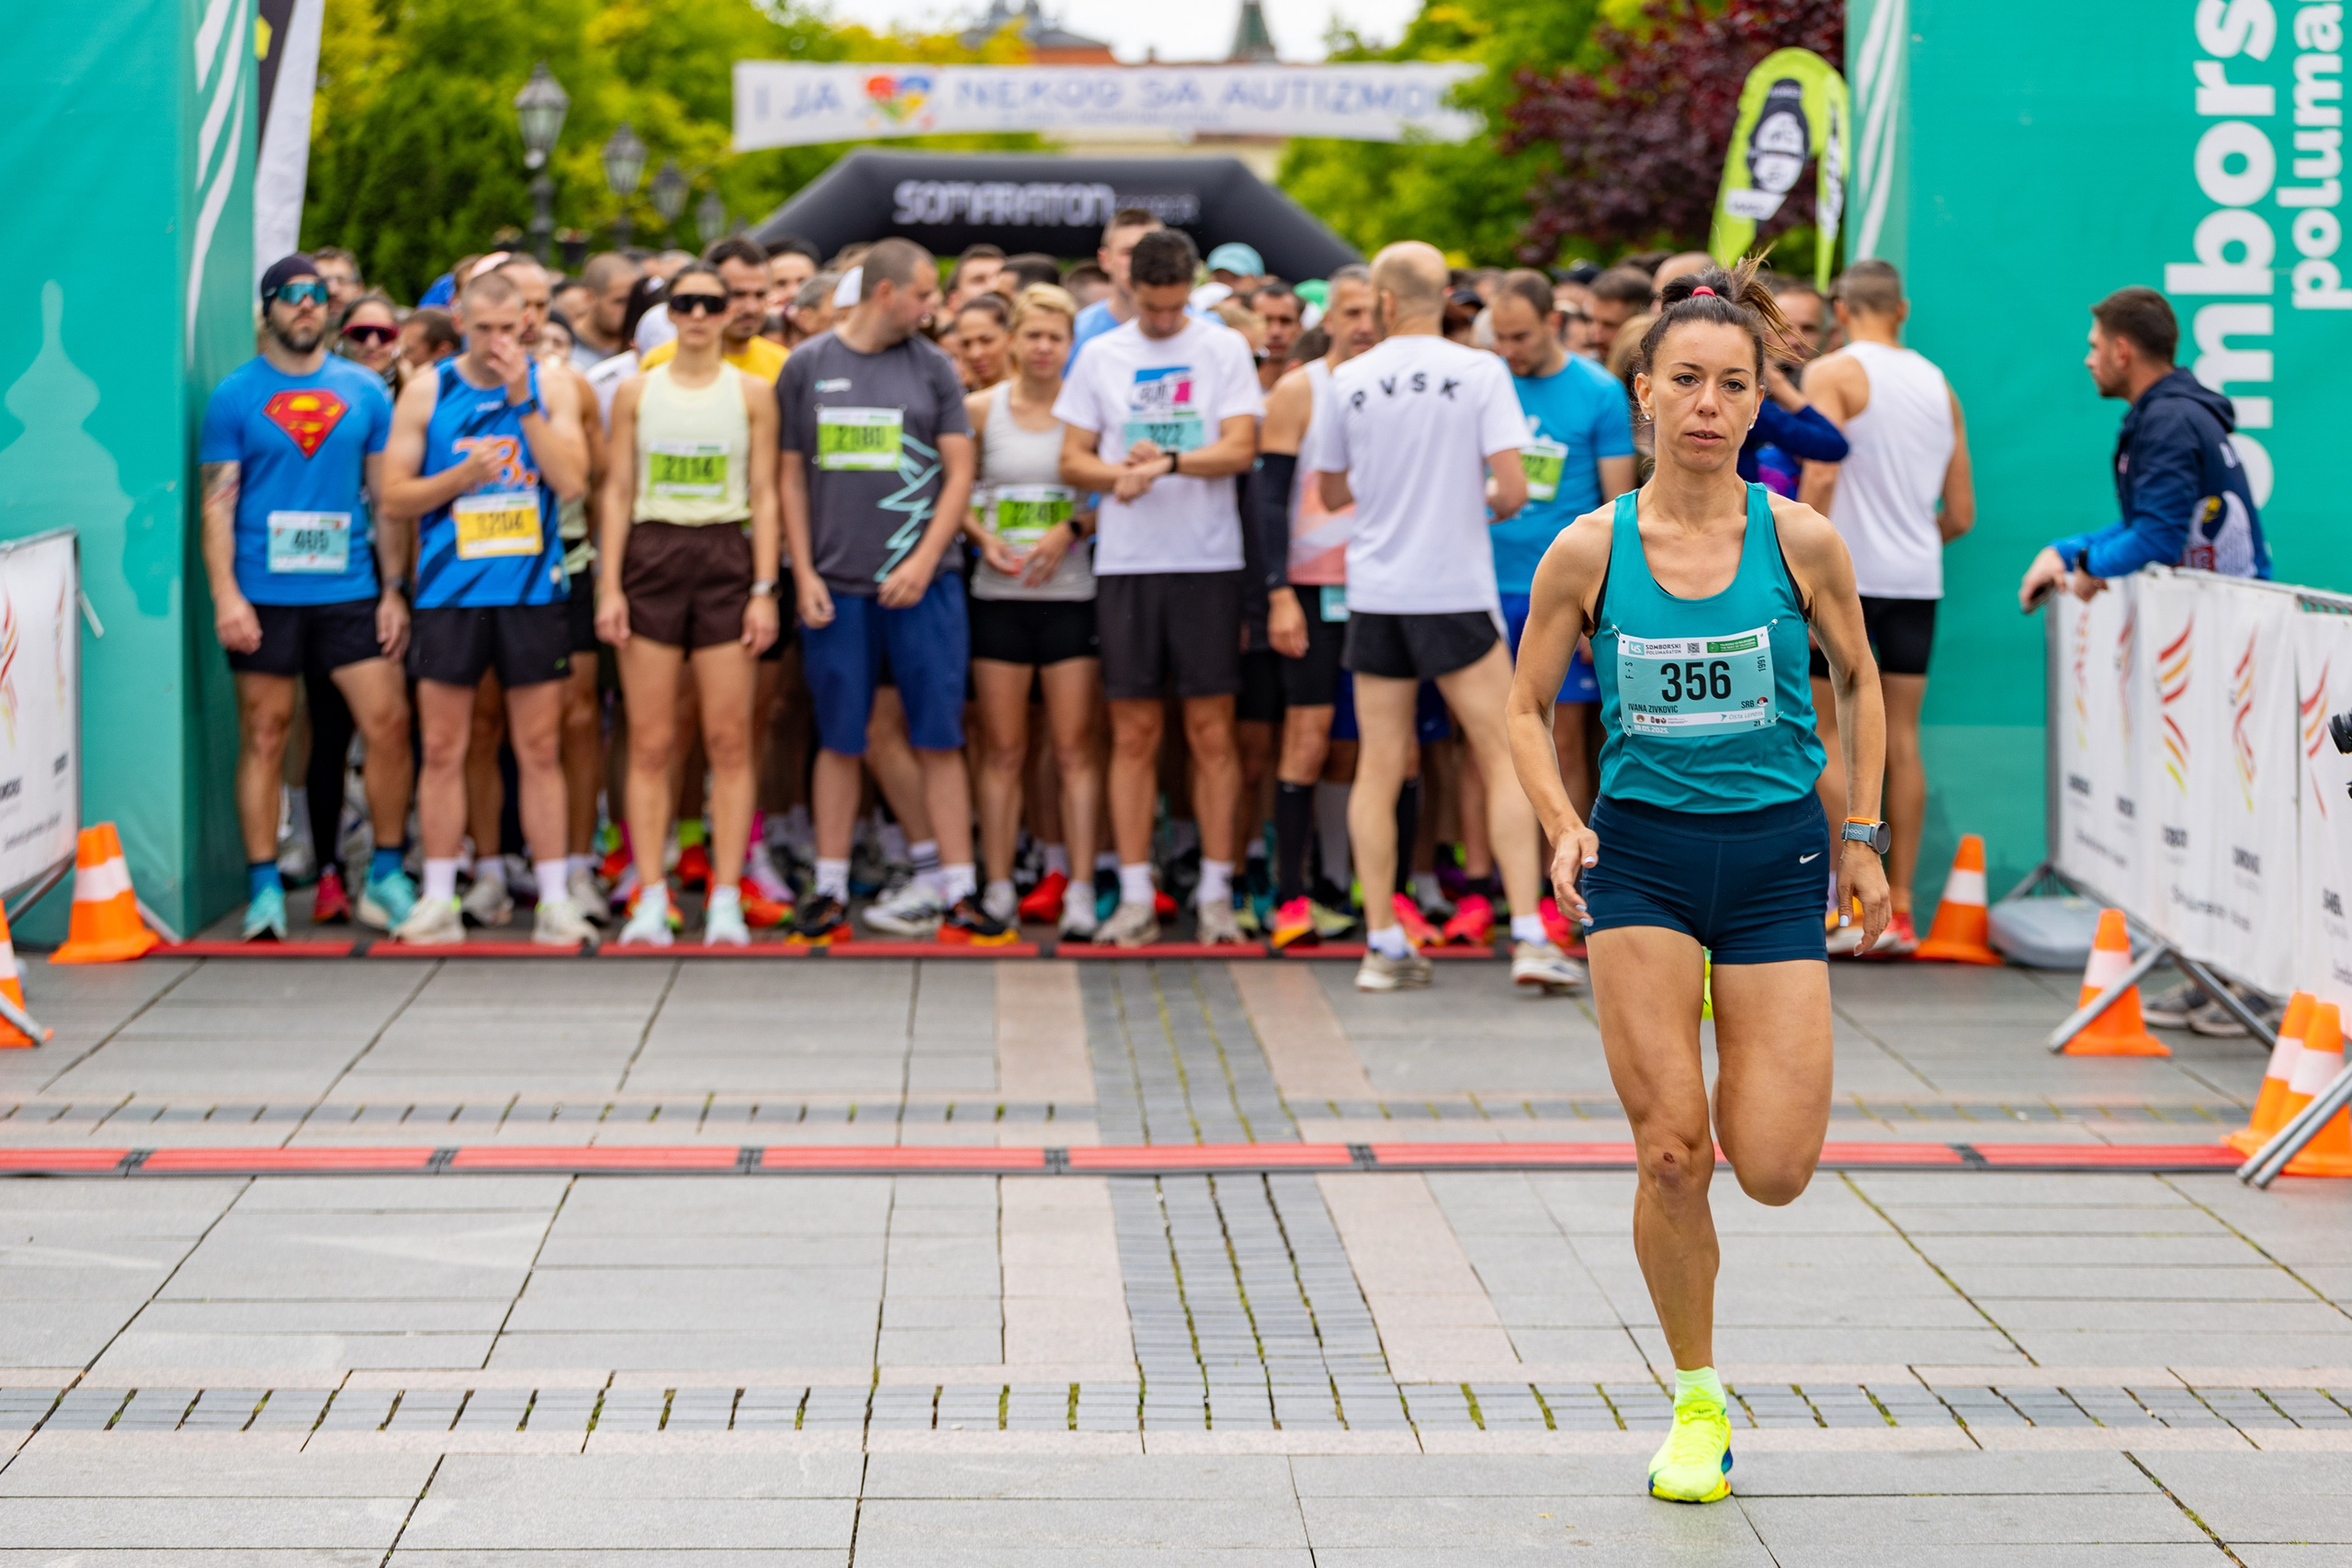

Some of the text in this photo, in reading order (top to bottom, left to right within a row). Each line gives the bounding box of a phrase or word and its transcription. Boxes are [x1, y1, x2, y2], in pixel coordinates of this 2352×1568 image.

[957, 77, 1123, 109] NEKOG
[1140, 78, 1202, 107] SA
[1757, 655, 1767, 672] 1991
[1660, 660, 1732, 703] 356
[1628, 704, 1679, 714] IVANA ZIVKOVIC
[1741, 700, 1755, 709] SRB
